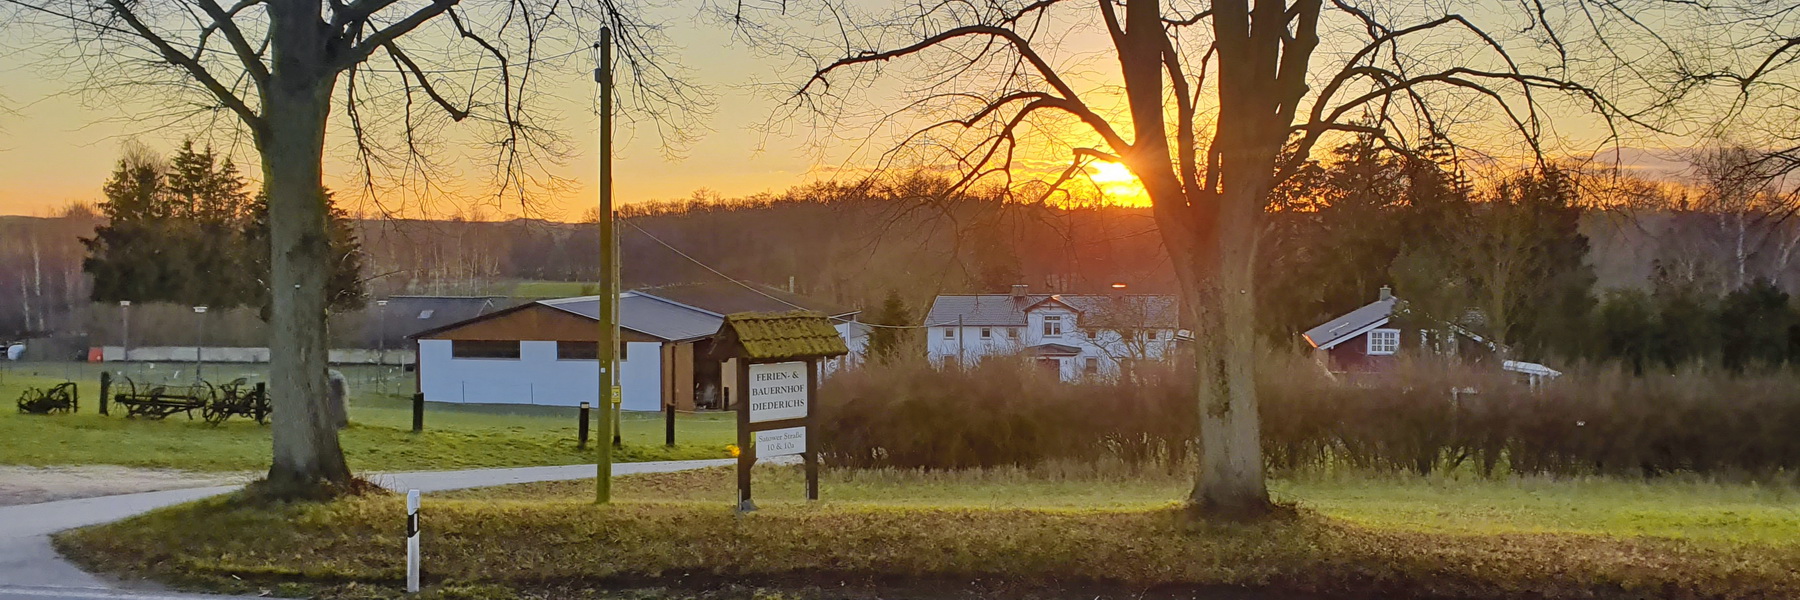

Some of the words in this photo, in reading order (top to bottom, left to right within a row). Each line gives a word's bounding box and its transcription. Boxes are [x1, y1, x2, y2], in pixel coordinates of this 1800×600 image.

[756, 372, 790, 381] FERIEN-
[792, 371, 799, 379] &
[752, 385, 804, 396] BAUERNHOF
[752, 399, 804, 411] DIEDERICHS
